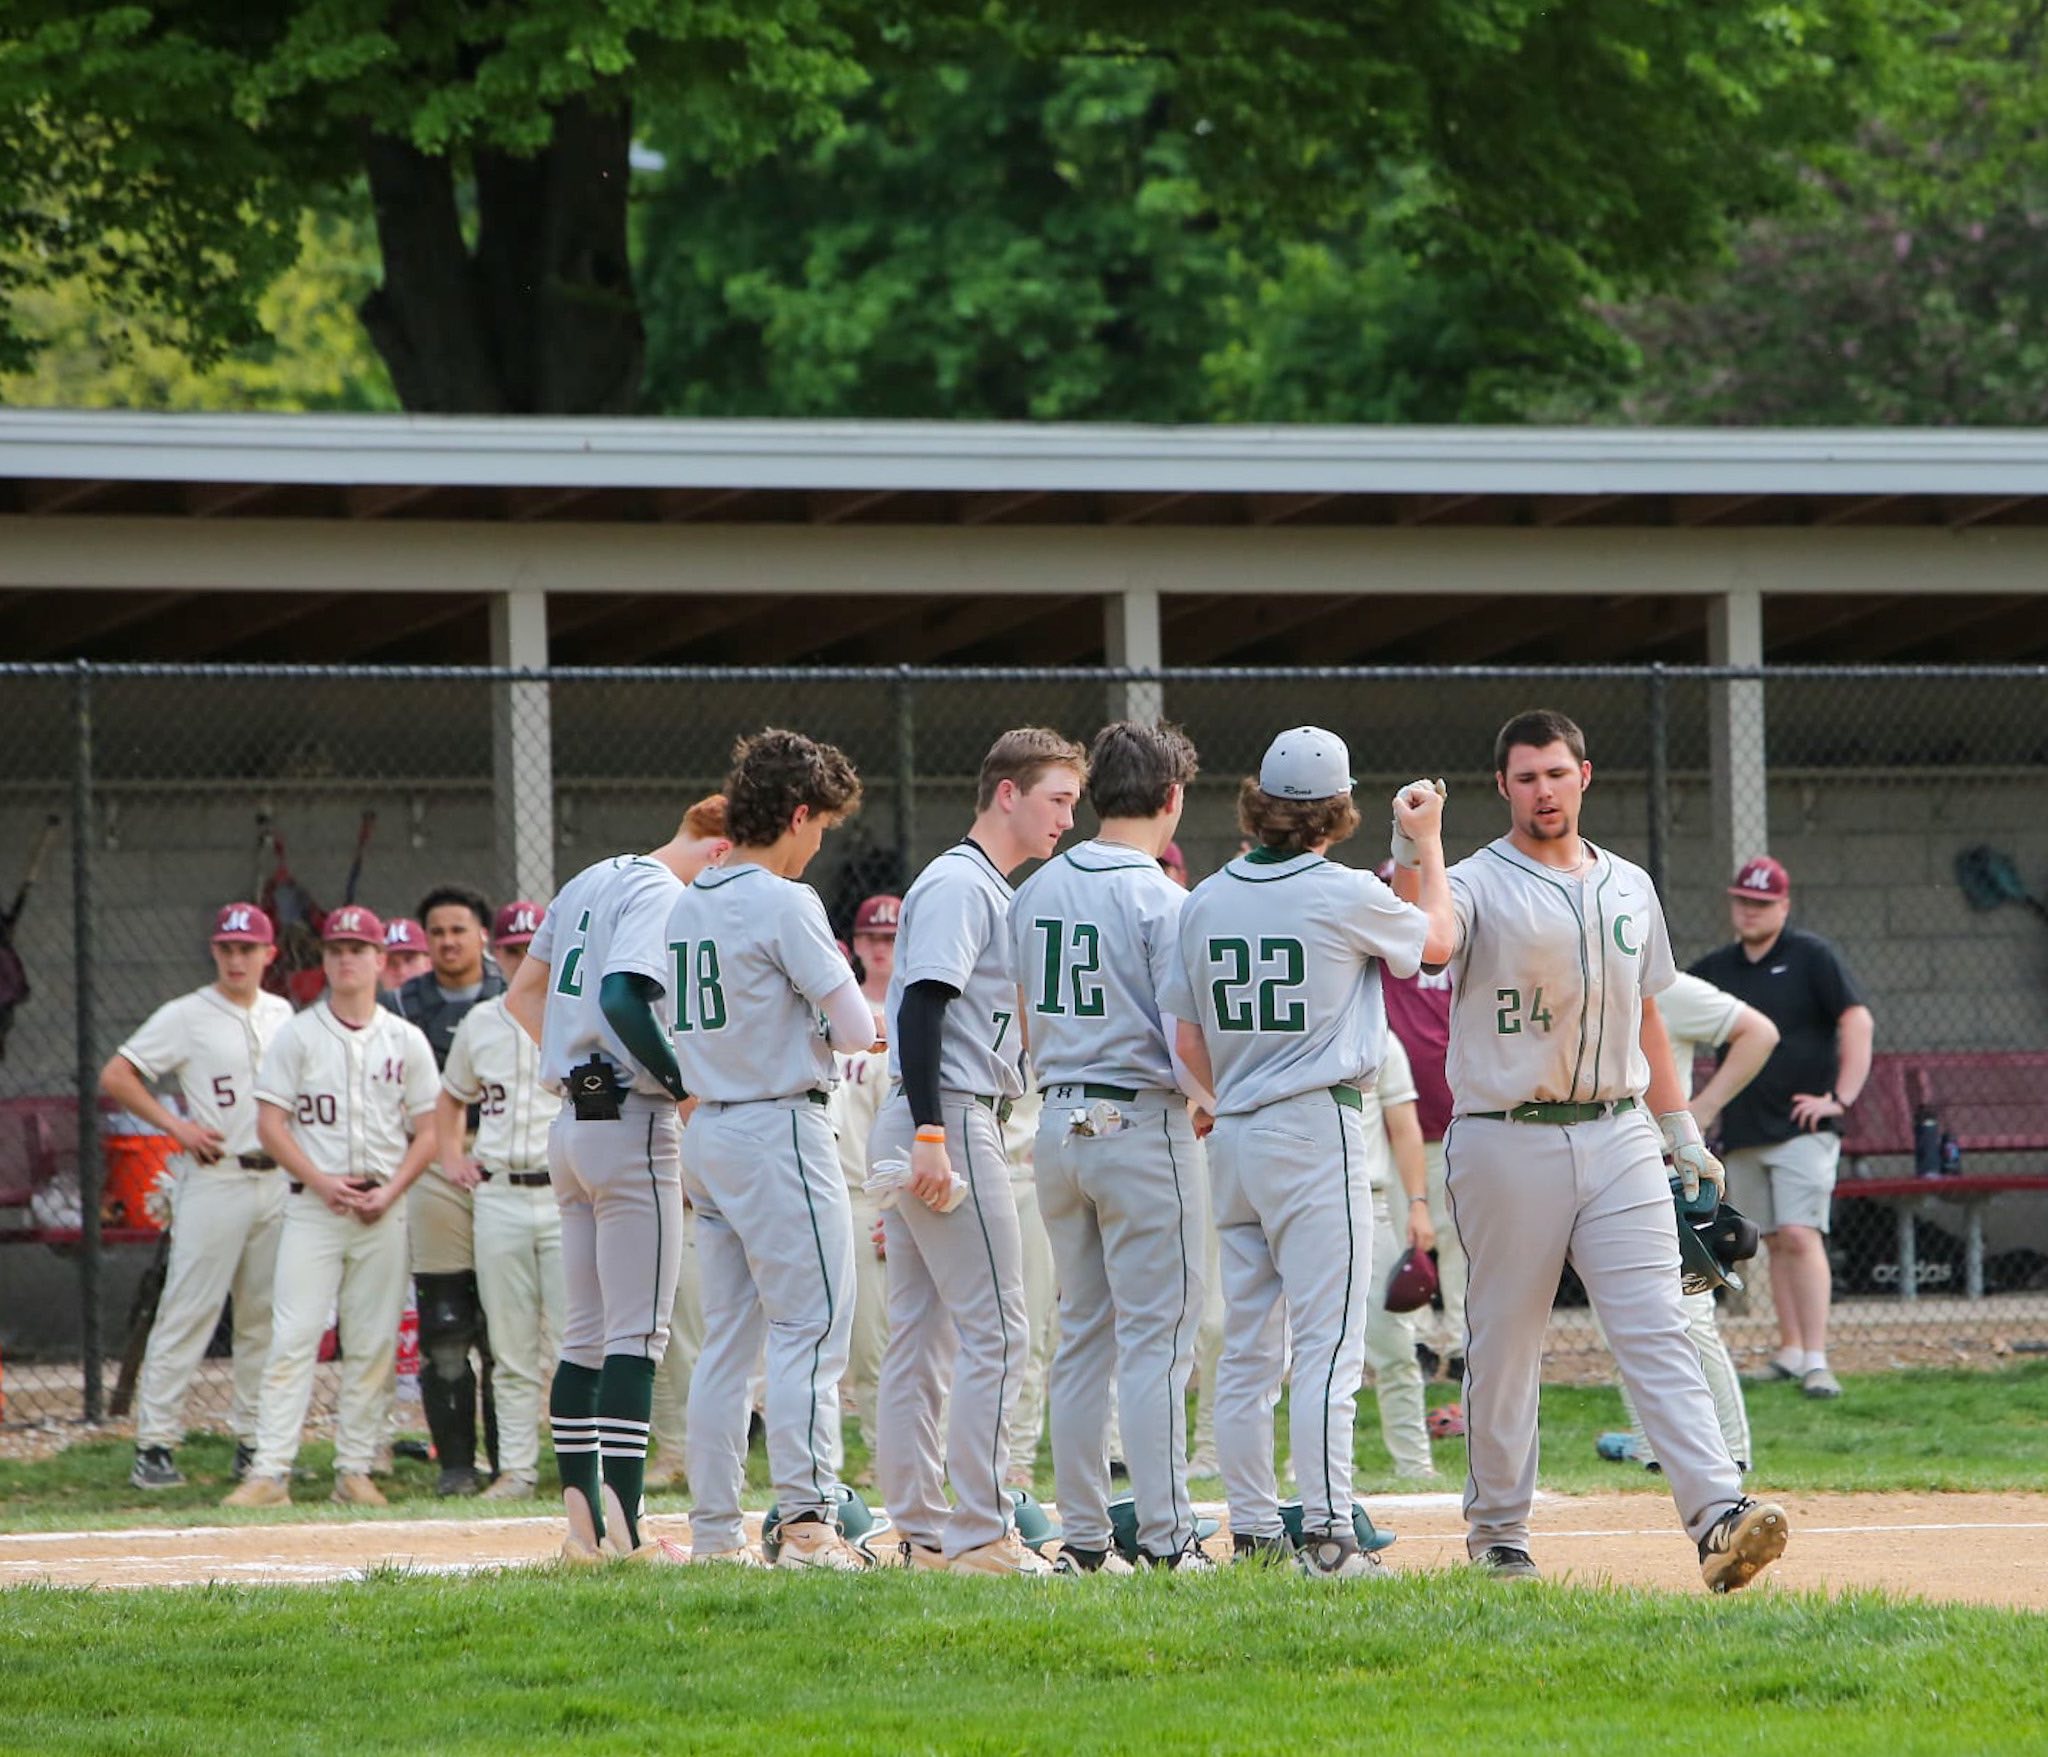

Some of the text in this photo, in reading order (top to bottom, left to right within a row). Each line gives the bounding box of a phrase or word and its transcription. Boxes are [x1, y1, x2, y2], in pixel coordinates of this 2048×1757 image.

[1613, 914, 1639, 957] C
[667, 937, 728, 1033] 18
[1033, 916, 1107, 1018] 12
[1207, 935, 1309, 1033] 22
[1497, 987, 1553, 1034] 24
[992, 1011, 1012, 1053] 7
[213, 1075, 236, 1107] 5
[298, 1094, 337, 1125] 20
[479, 1084, 506, 1116] 22
[1872, 1260, 1950, 1283] addas
